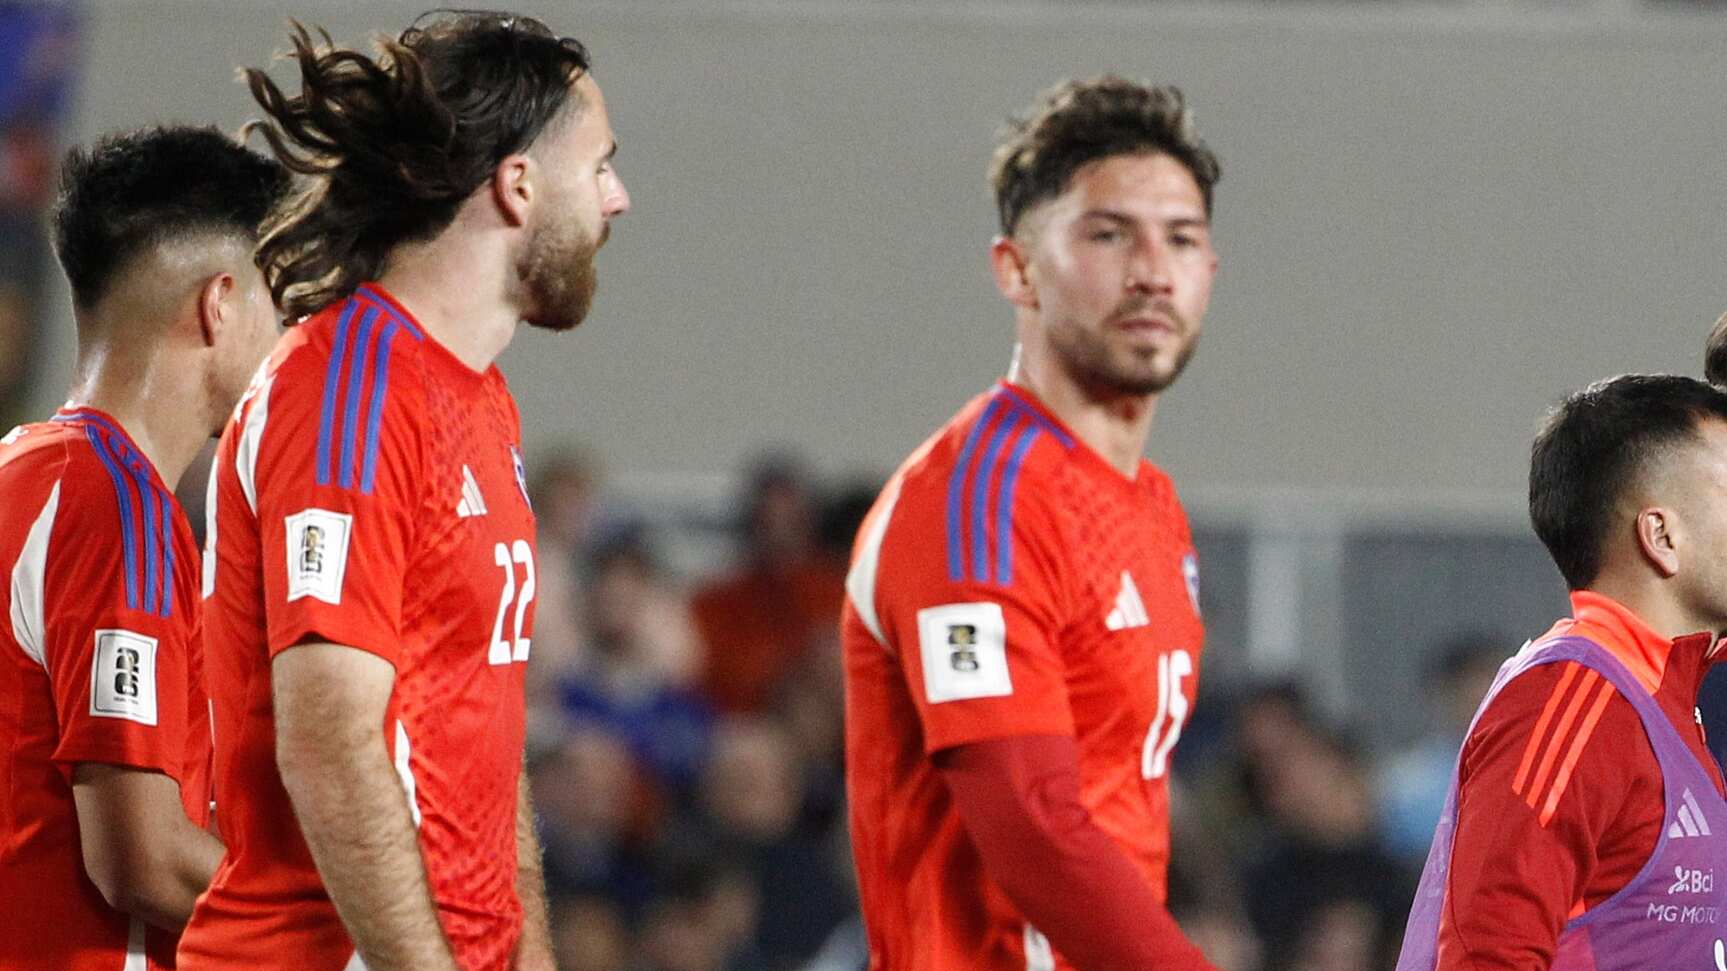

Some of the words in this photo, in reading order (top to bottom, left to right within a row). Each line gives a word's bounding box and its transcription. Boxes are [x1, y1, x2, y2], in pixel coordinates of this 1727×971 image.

[487, 539, 537, 665] 22
[1141, 648, 1193, 780] 15
[1646, 902, 1679, 922] MG
